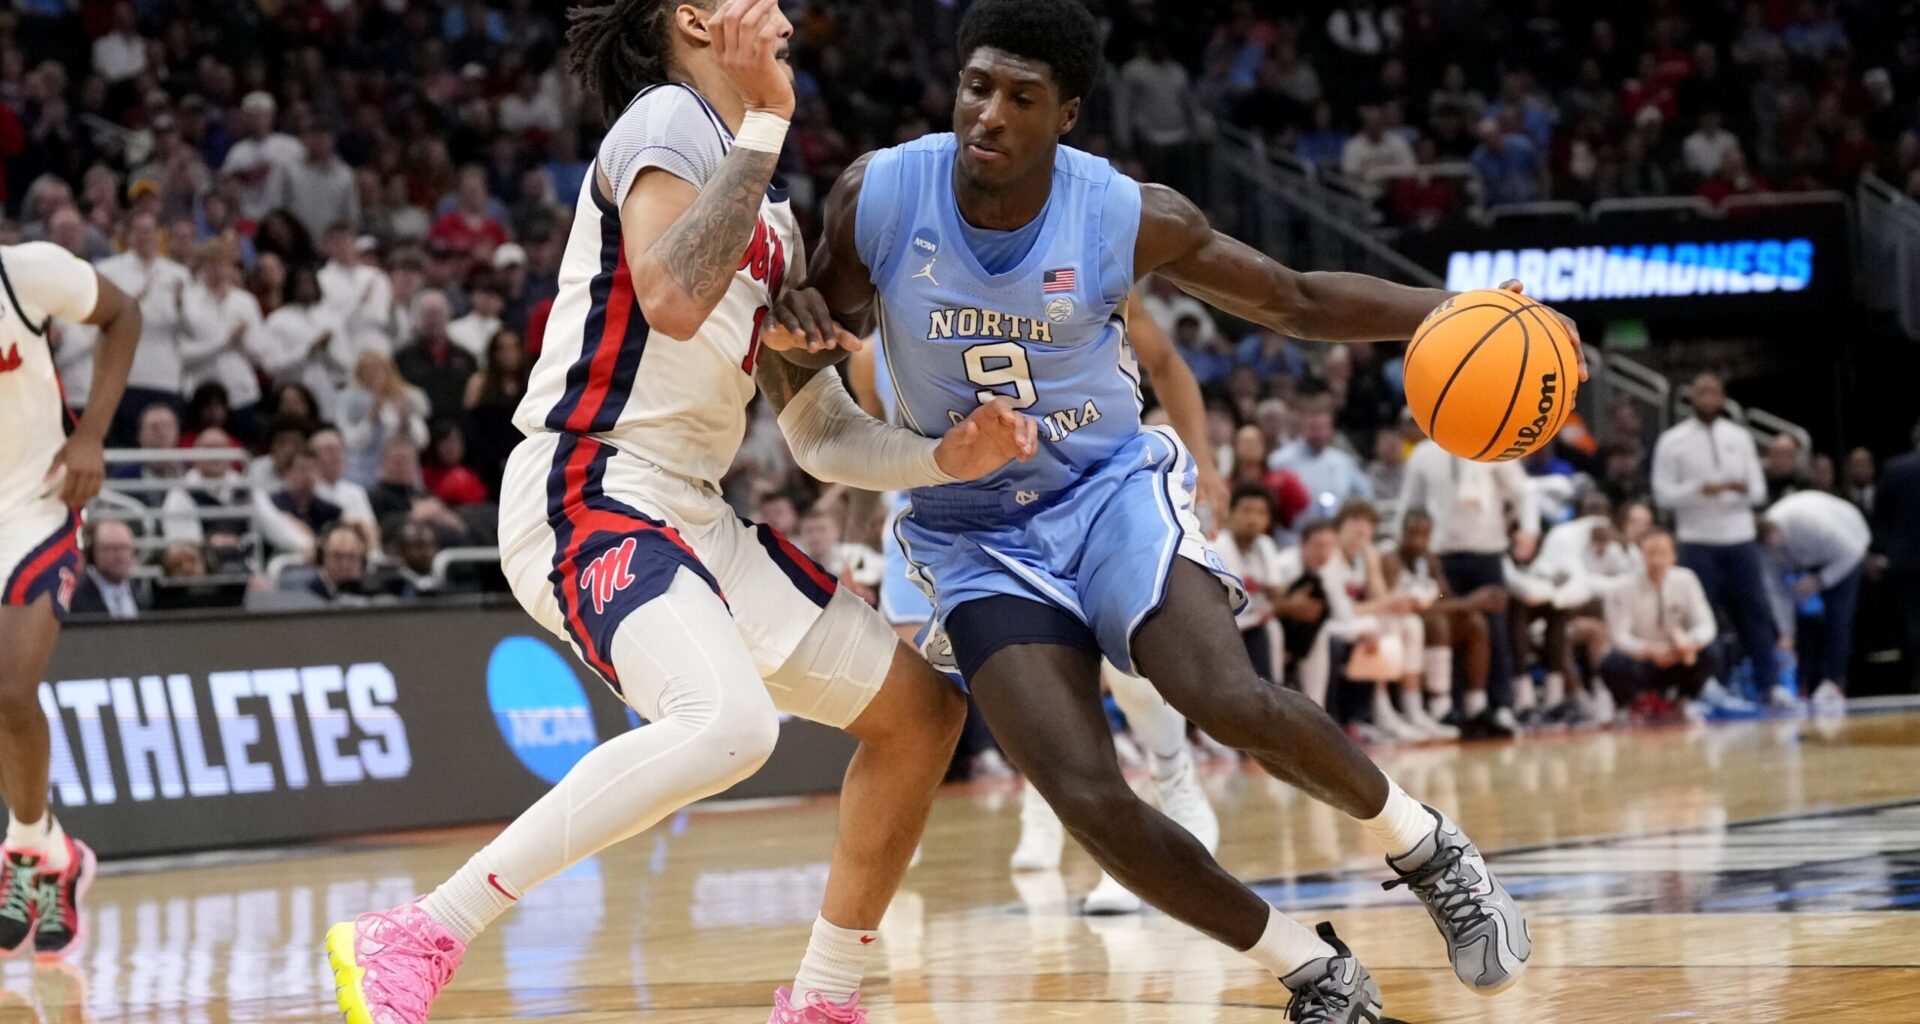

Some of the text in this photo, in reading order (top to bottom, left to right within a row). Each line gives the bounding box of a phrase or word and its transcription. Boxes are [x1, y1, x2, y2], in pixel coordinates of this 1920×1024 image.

[927, 307, 1053, 343] NORTH
[962, 340, 1038, 410] 9
[38, 663, 412, 806] ATHLETES
[507, 707, 597, 747] NCAA
